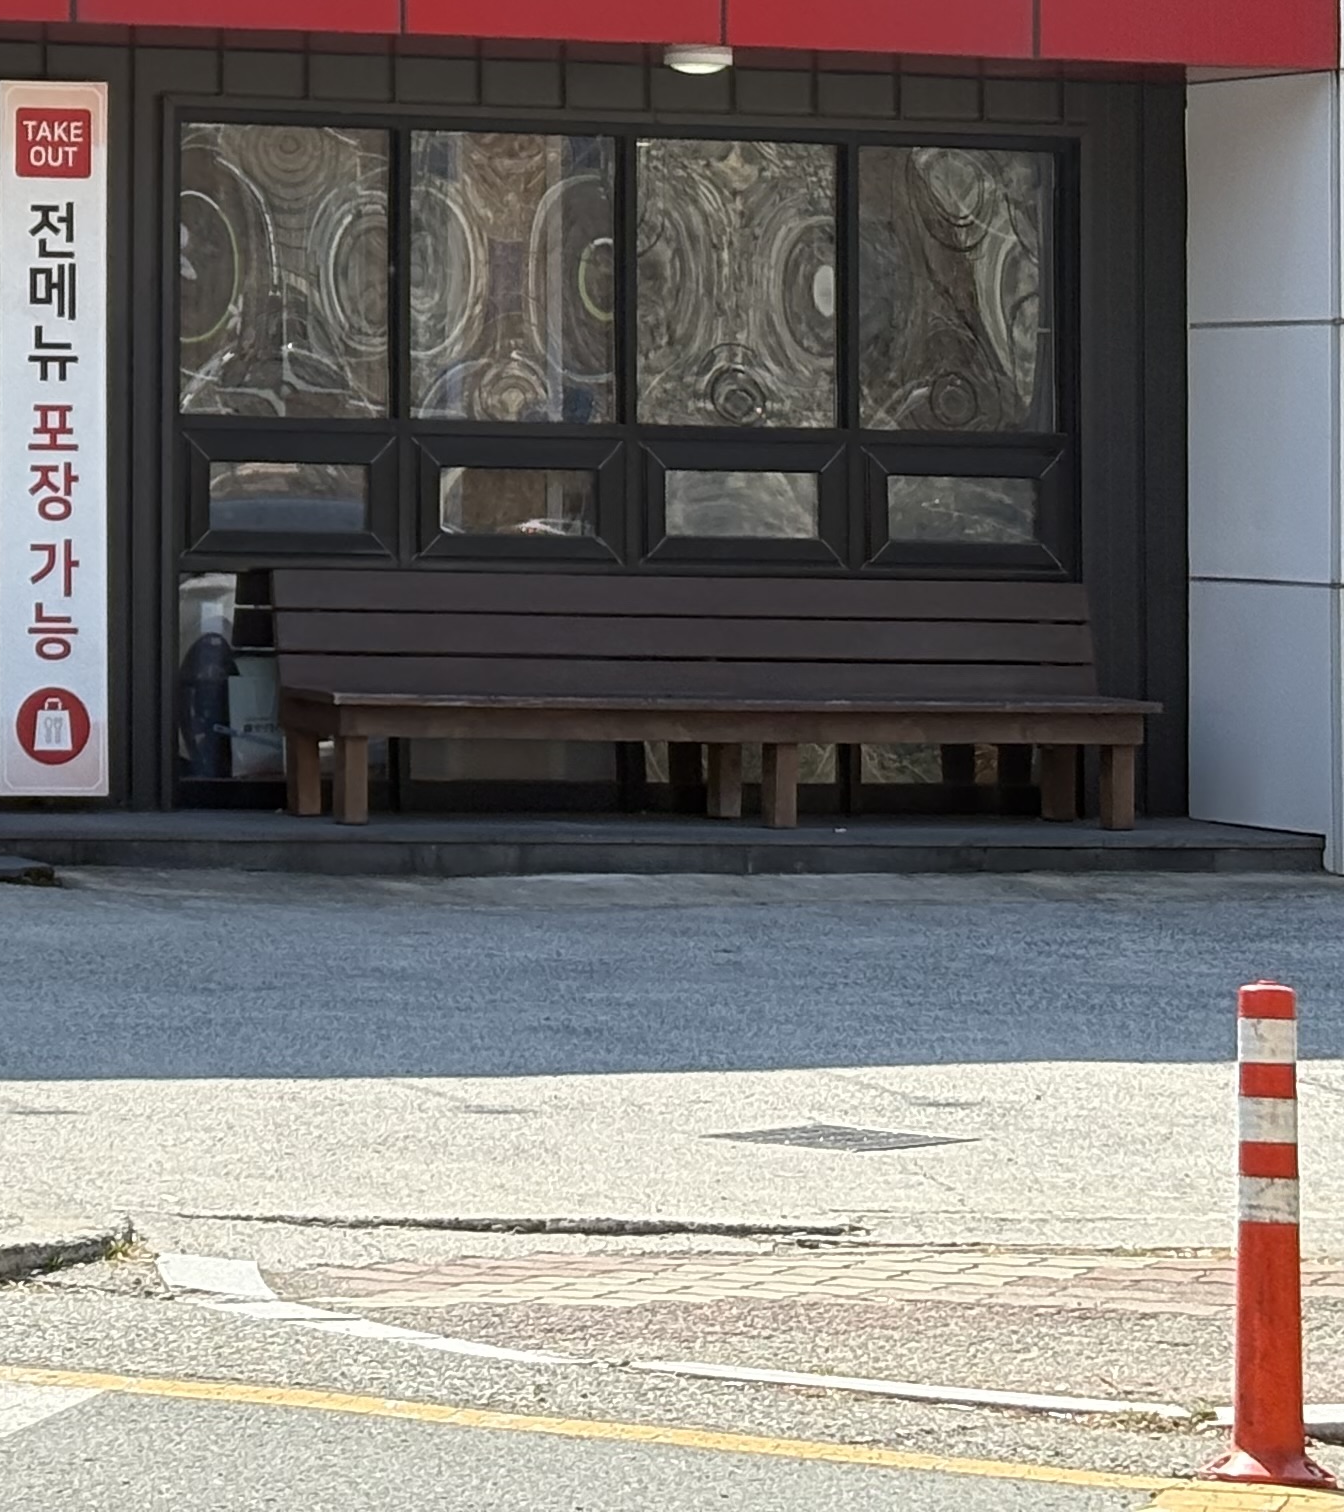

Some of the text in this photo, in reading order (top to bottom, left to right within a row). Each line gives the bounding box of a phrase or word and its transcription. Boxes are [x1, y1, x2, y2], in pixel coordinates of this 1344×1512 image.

[23, 120, 83, 143] TAKE
[29, 146, 78, 168] OUT
[27, 202, 79, 381] 전메뉴
